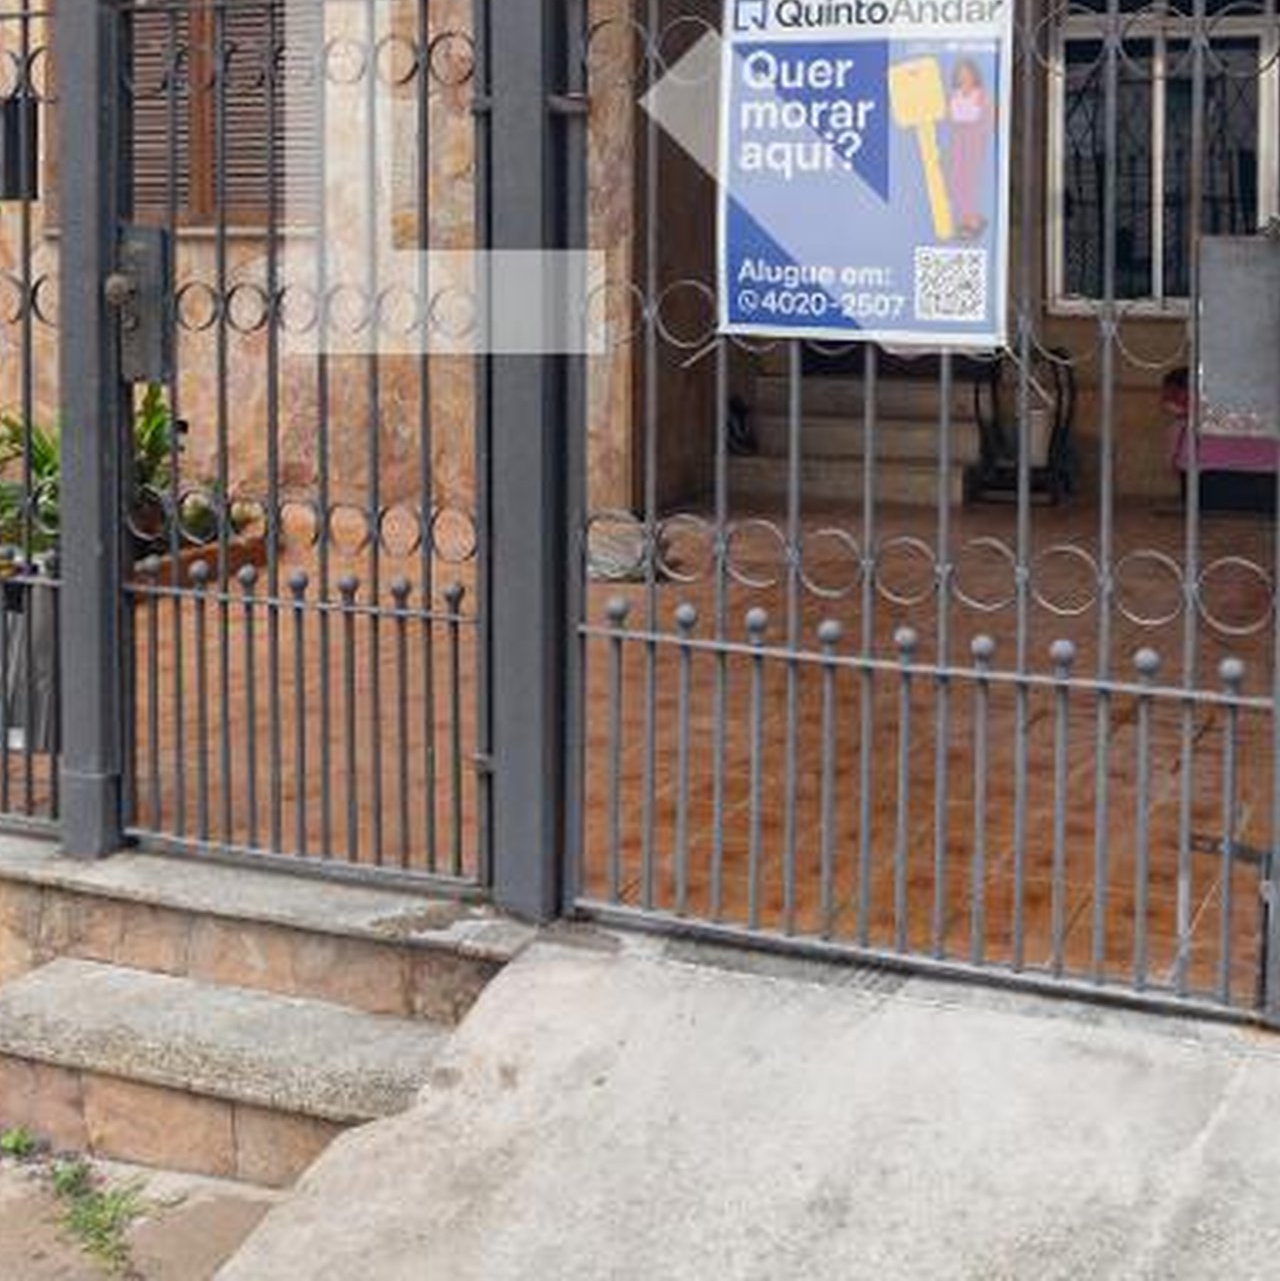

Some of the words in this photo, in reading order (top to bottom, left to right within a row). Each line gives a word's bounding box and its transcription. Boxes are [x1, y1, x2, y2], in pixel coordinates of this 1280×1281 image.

[742, 50, 854, 89] Quer
[740, 99, 875, 129] morar
[740, 130, 862, 180] aqui?
[737, 259, 835, 288] Alugue
[840, 267, 893, 286] em:
[761, 291, 906, 320] 4020-2507
